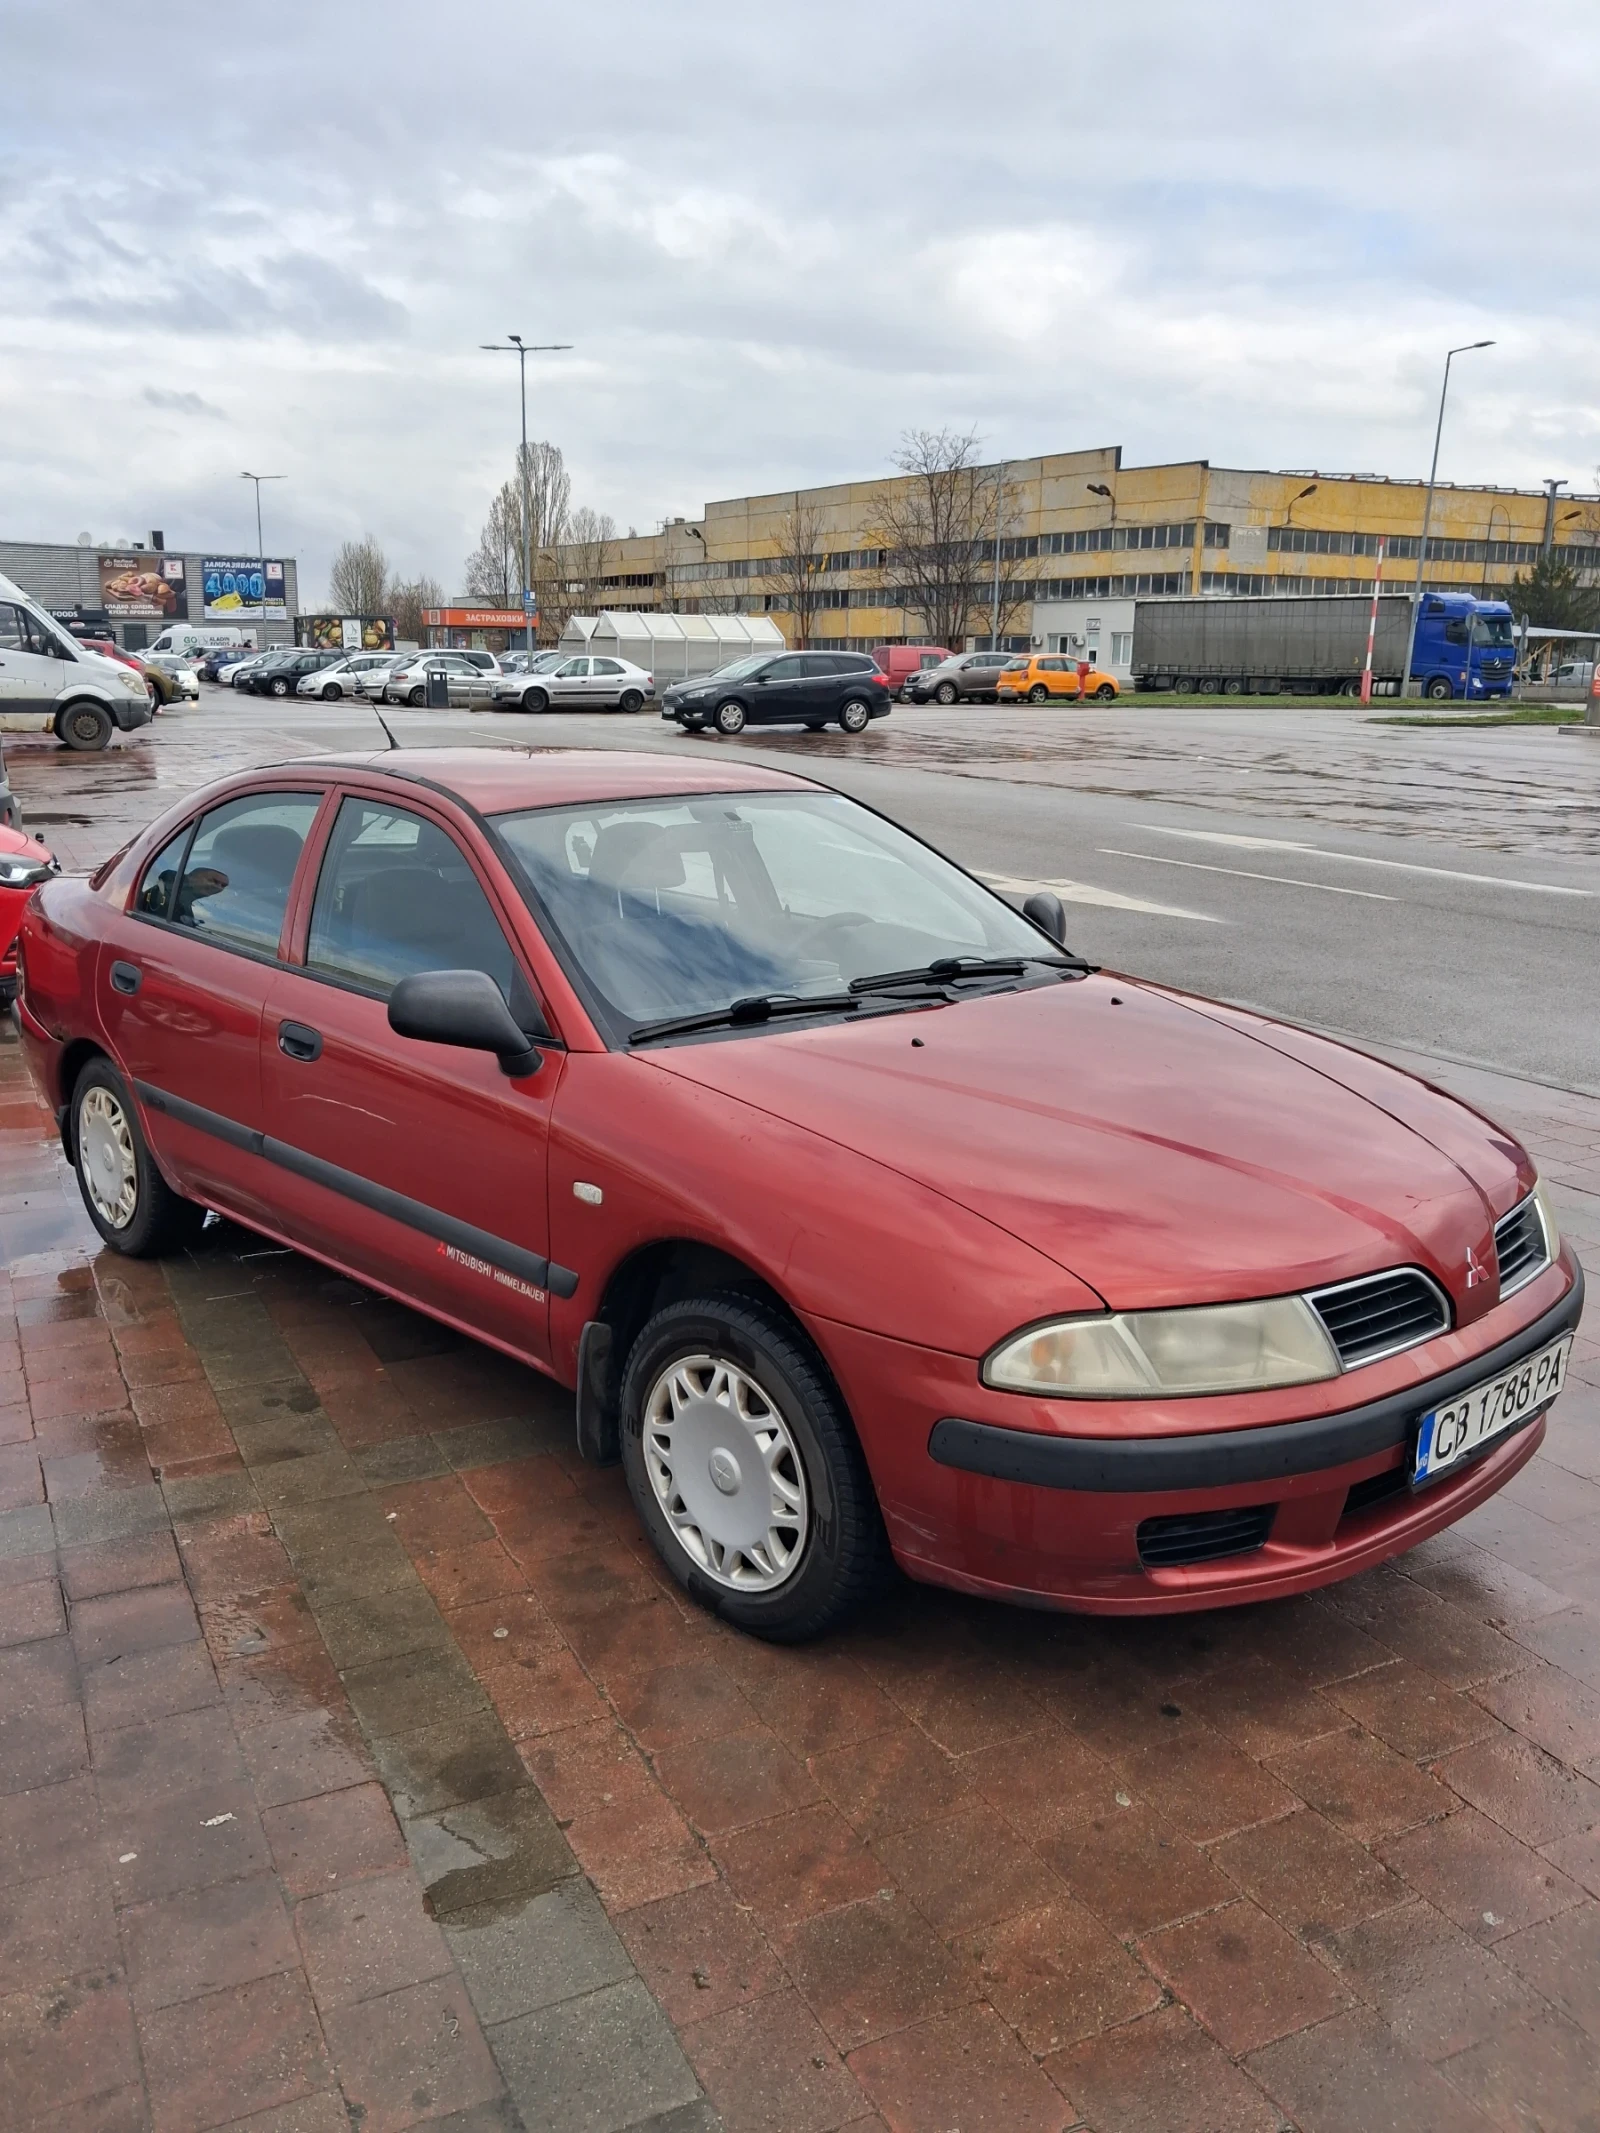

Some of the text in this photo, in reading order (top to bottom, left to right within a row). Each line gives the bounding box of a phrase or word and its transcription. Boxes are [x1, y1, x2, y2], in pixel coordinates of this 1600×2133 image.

[205, 573, 266, 598] 4000
[465, 613, 523, 623] ЗАСТРАХОВКИ
[446, 1245, 546, 1304] MITSUBISHI HIMMELBAUER
[1435, 1346, 1563, 1460] CB 1788 PA
